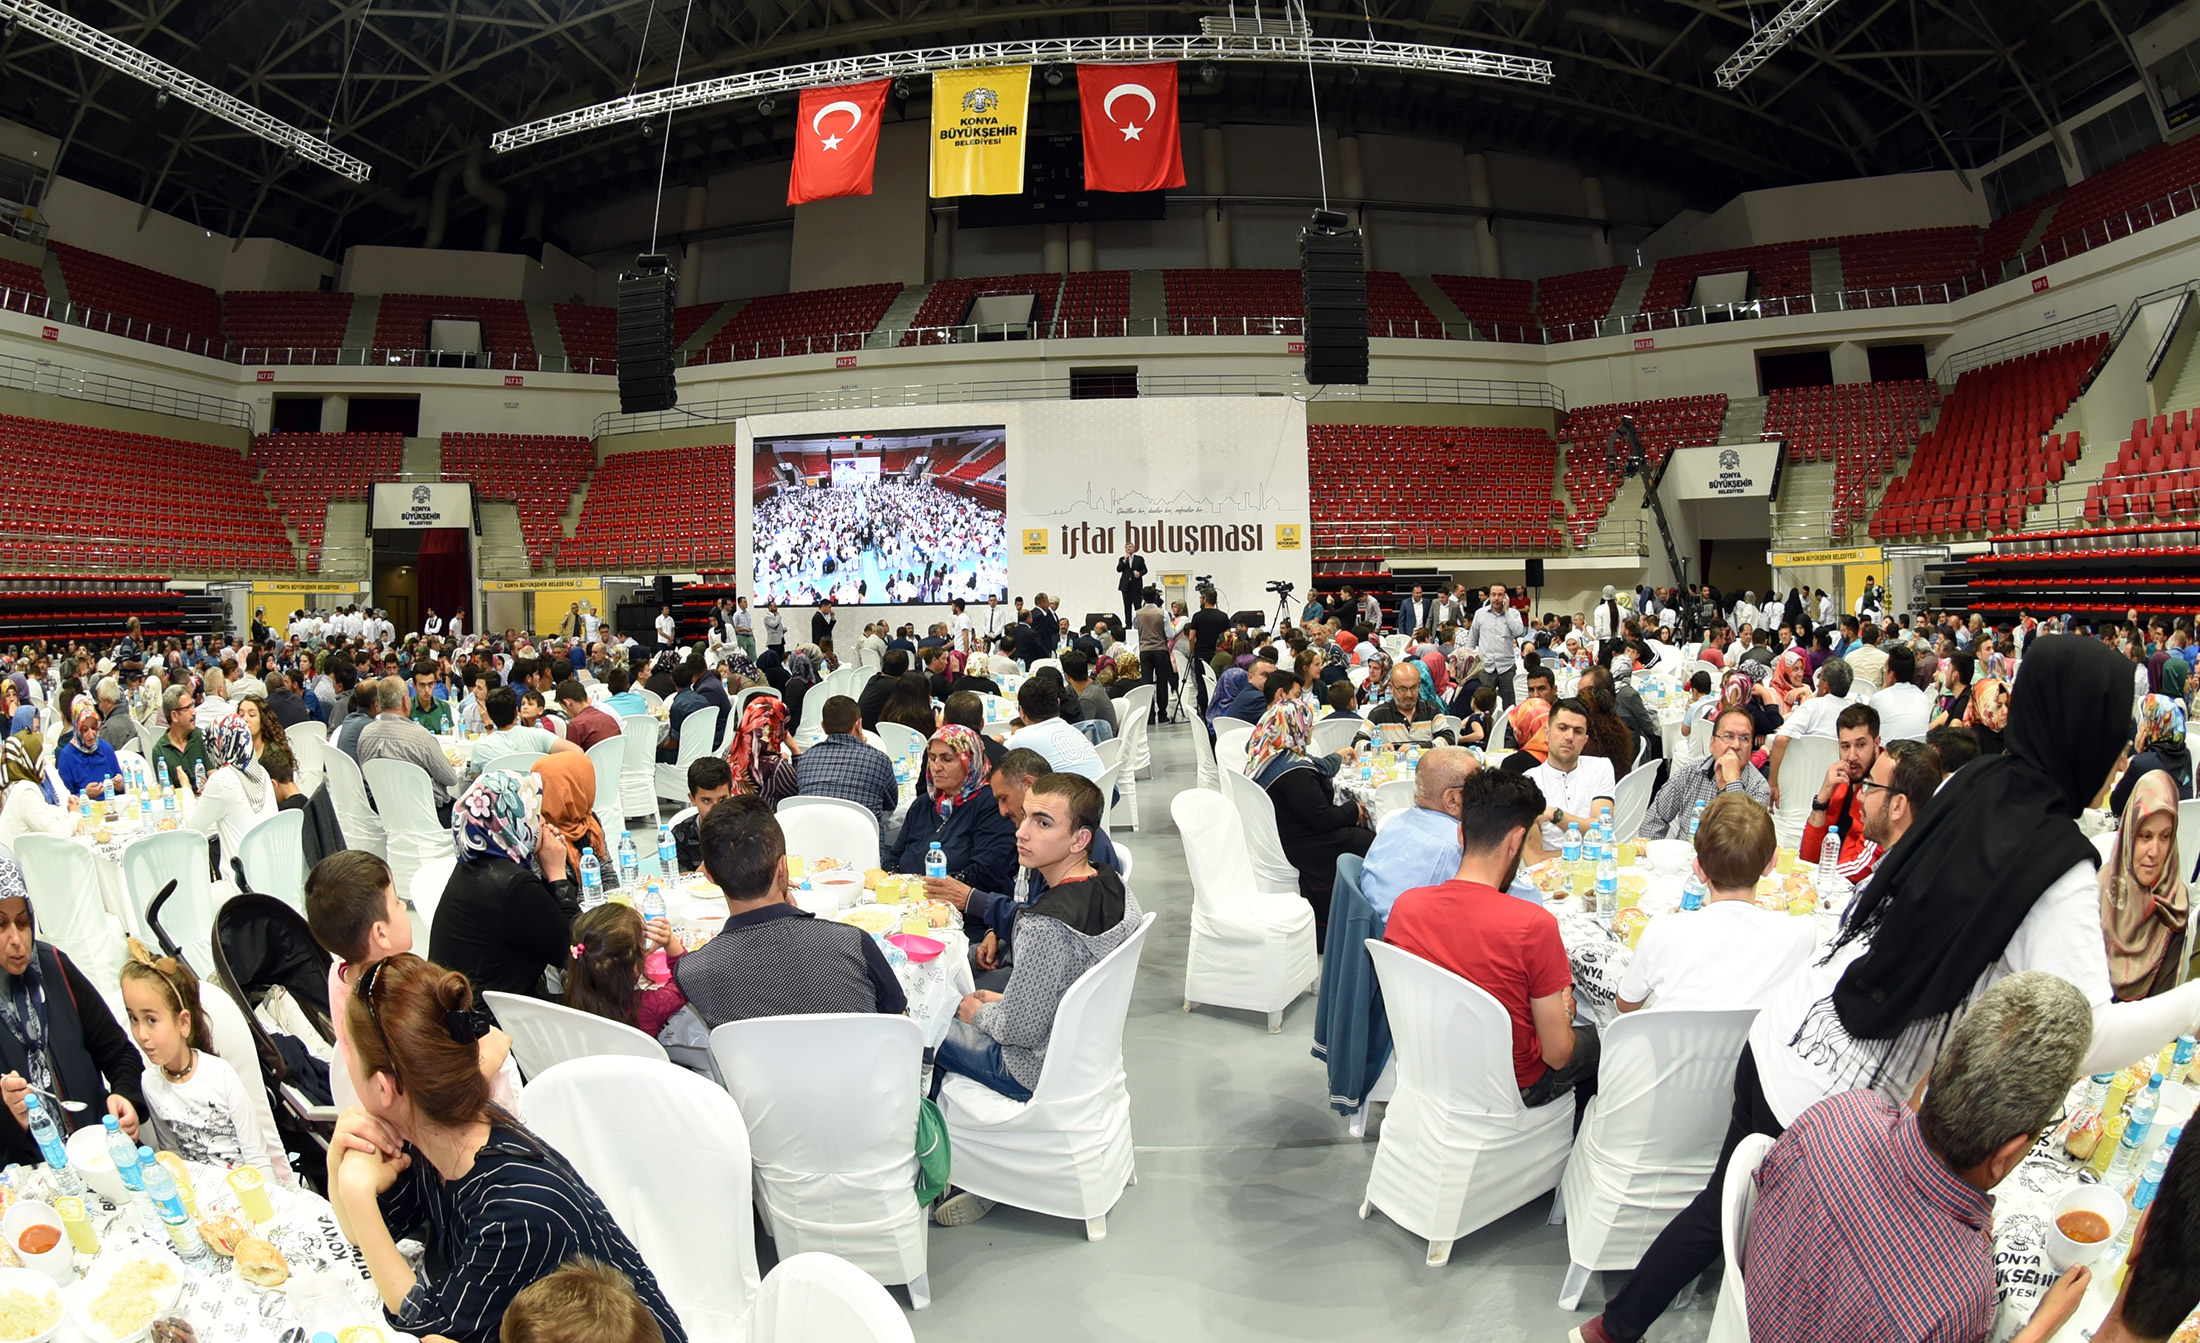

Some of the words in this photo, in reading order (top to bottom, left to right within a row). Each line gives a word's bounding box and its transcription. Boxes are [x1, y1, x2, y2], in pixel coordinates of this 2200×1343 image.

[960, 117, 998, 126] KONYA
[940, 124, 1018, 140] BÜYÜKŞEHİR
[955, 137, 1002, 147] BELEDİYESİ
[44, 328, 53, 337] ALT
[1709, 478, 1753, 489] BÜYÜKŞEHİR
[401, 511, 441, 521] BÜYÜKŞEHİR
[1061, 521, 1116, 559] iftar
[1125, 519, 1264, 556] buluşması
[1806, 553, 1832, 561] BÜYÜKŞEHİR
[1832, 551, 1857, 560] BELEDİYESİ
[519, 580, 548, 588] BÜYÜKŞEHİR
[548, 579, 575, 587] BELEDİYESİ
[317, 1213, 348, 1261] KONYA
